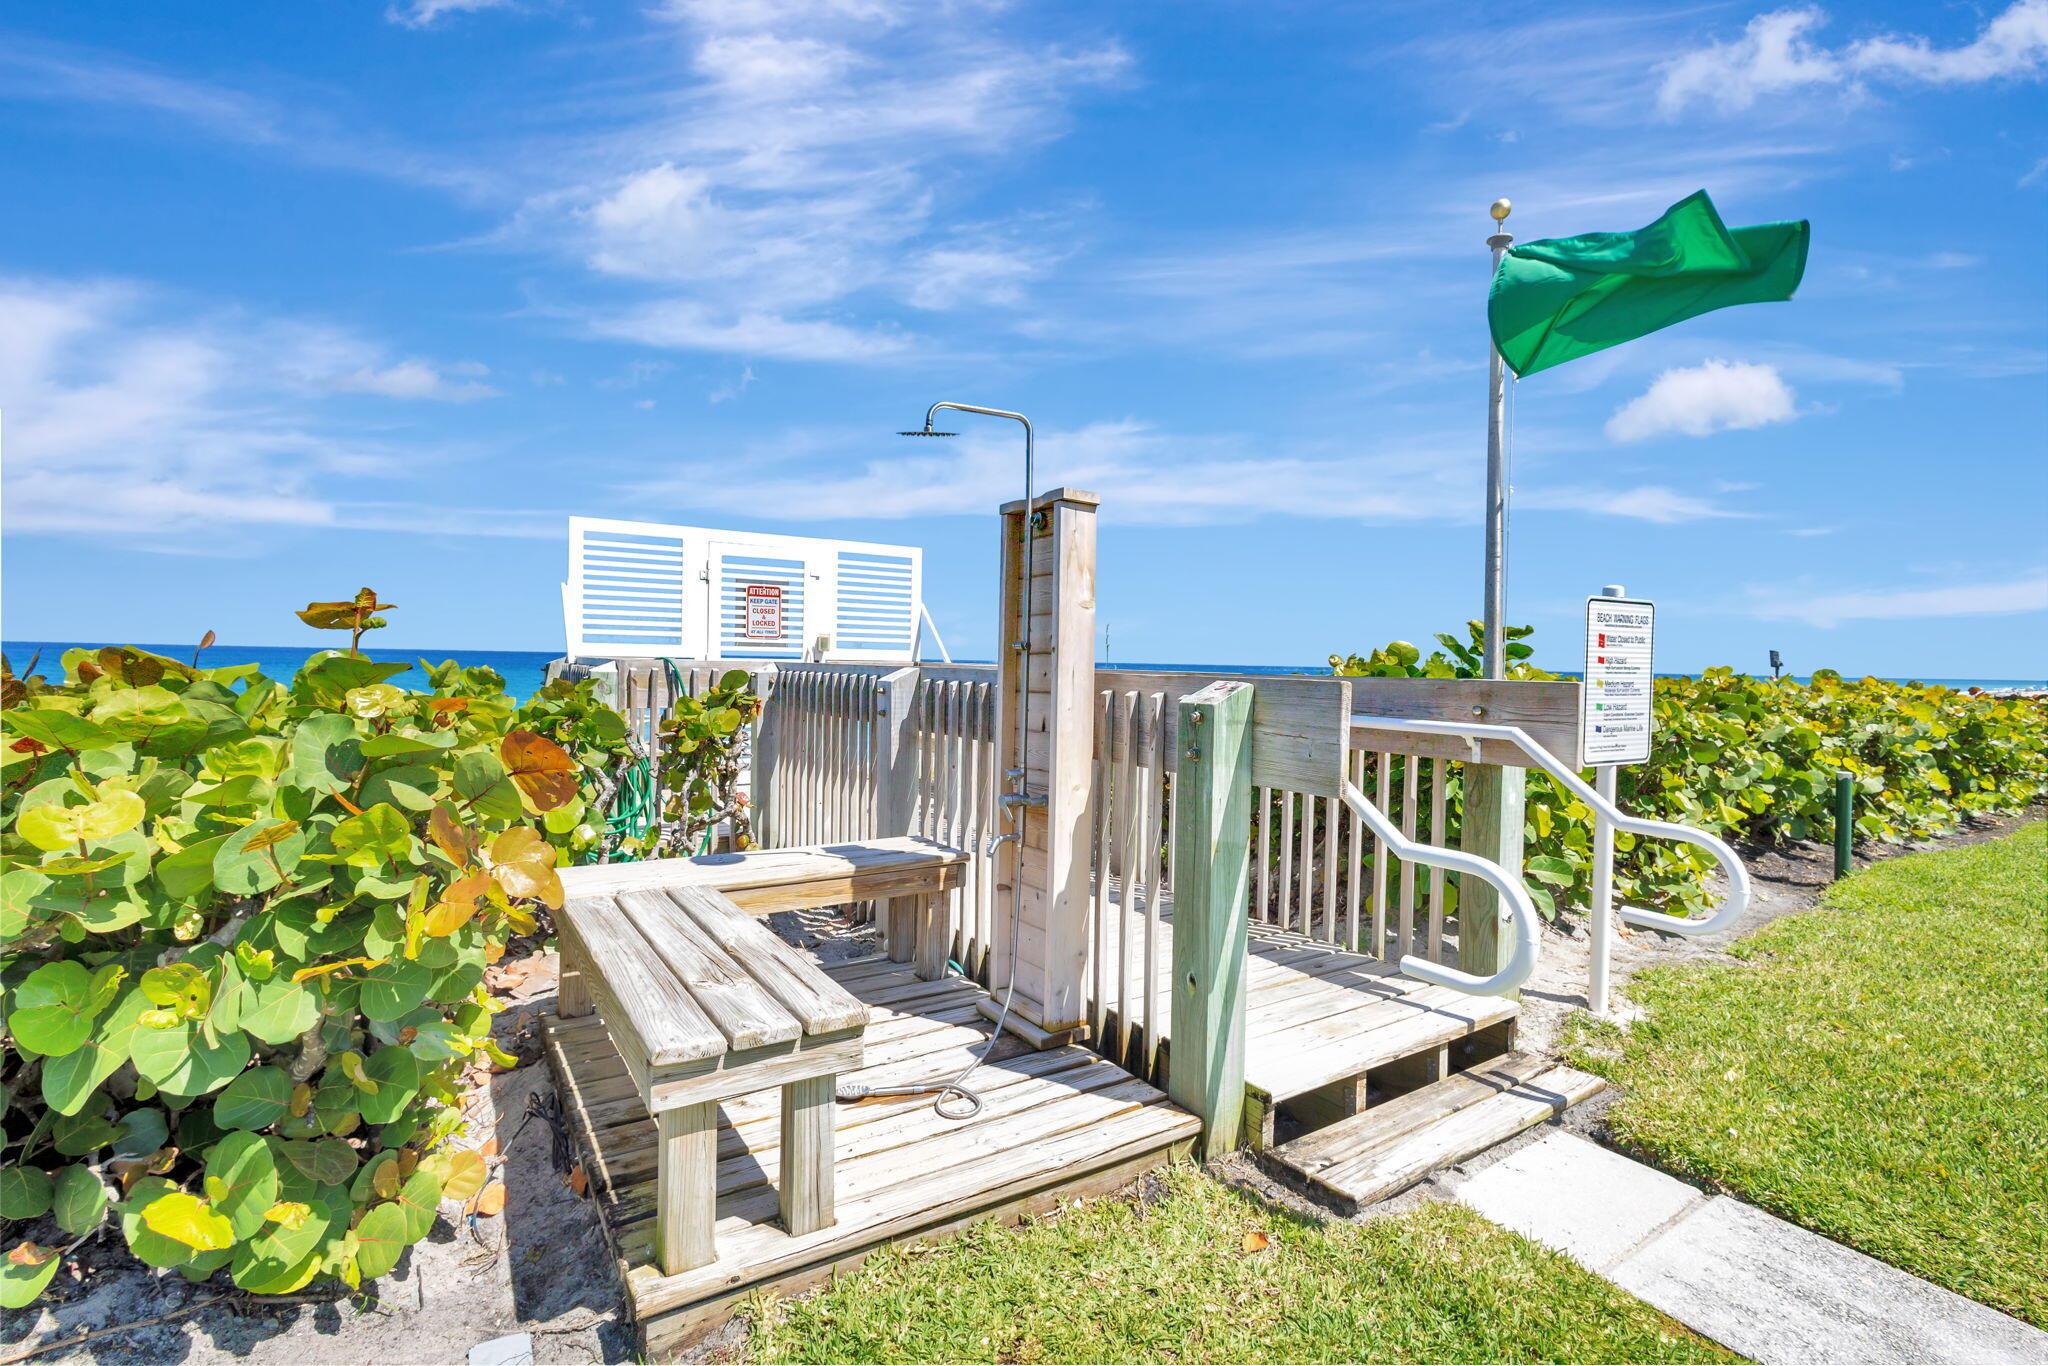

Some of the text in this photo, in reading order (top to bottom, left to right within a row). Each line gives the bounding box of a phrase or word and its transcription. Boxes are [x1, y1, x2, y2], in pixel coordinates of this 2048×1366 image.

[750, 588, 778, 596] ATTENTION
[1597, 612, 1649, 625] BEACH WARNING FLAGS
[1618, 635, 1630, 643] Closed
